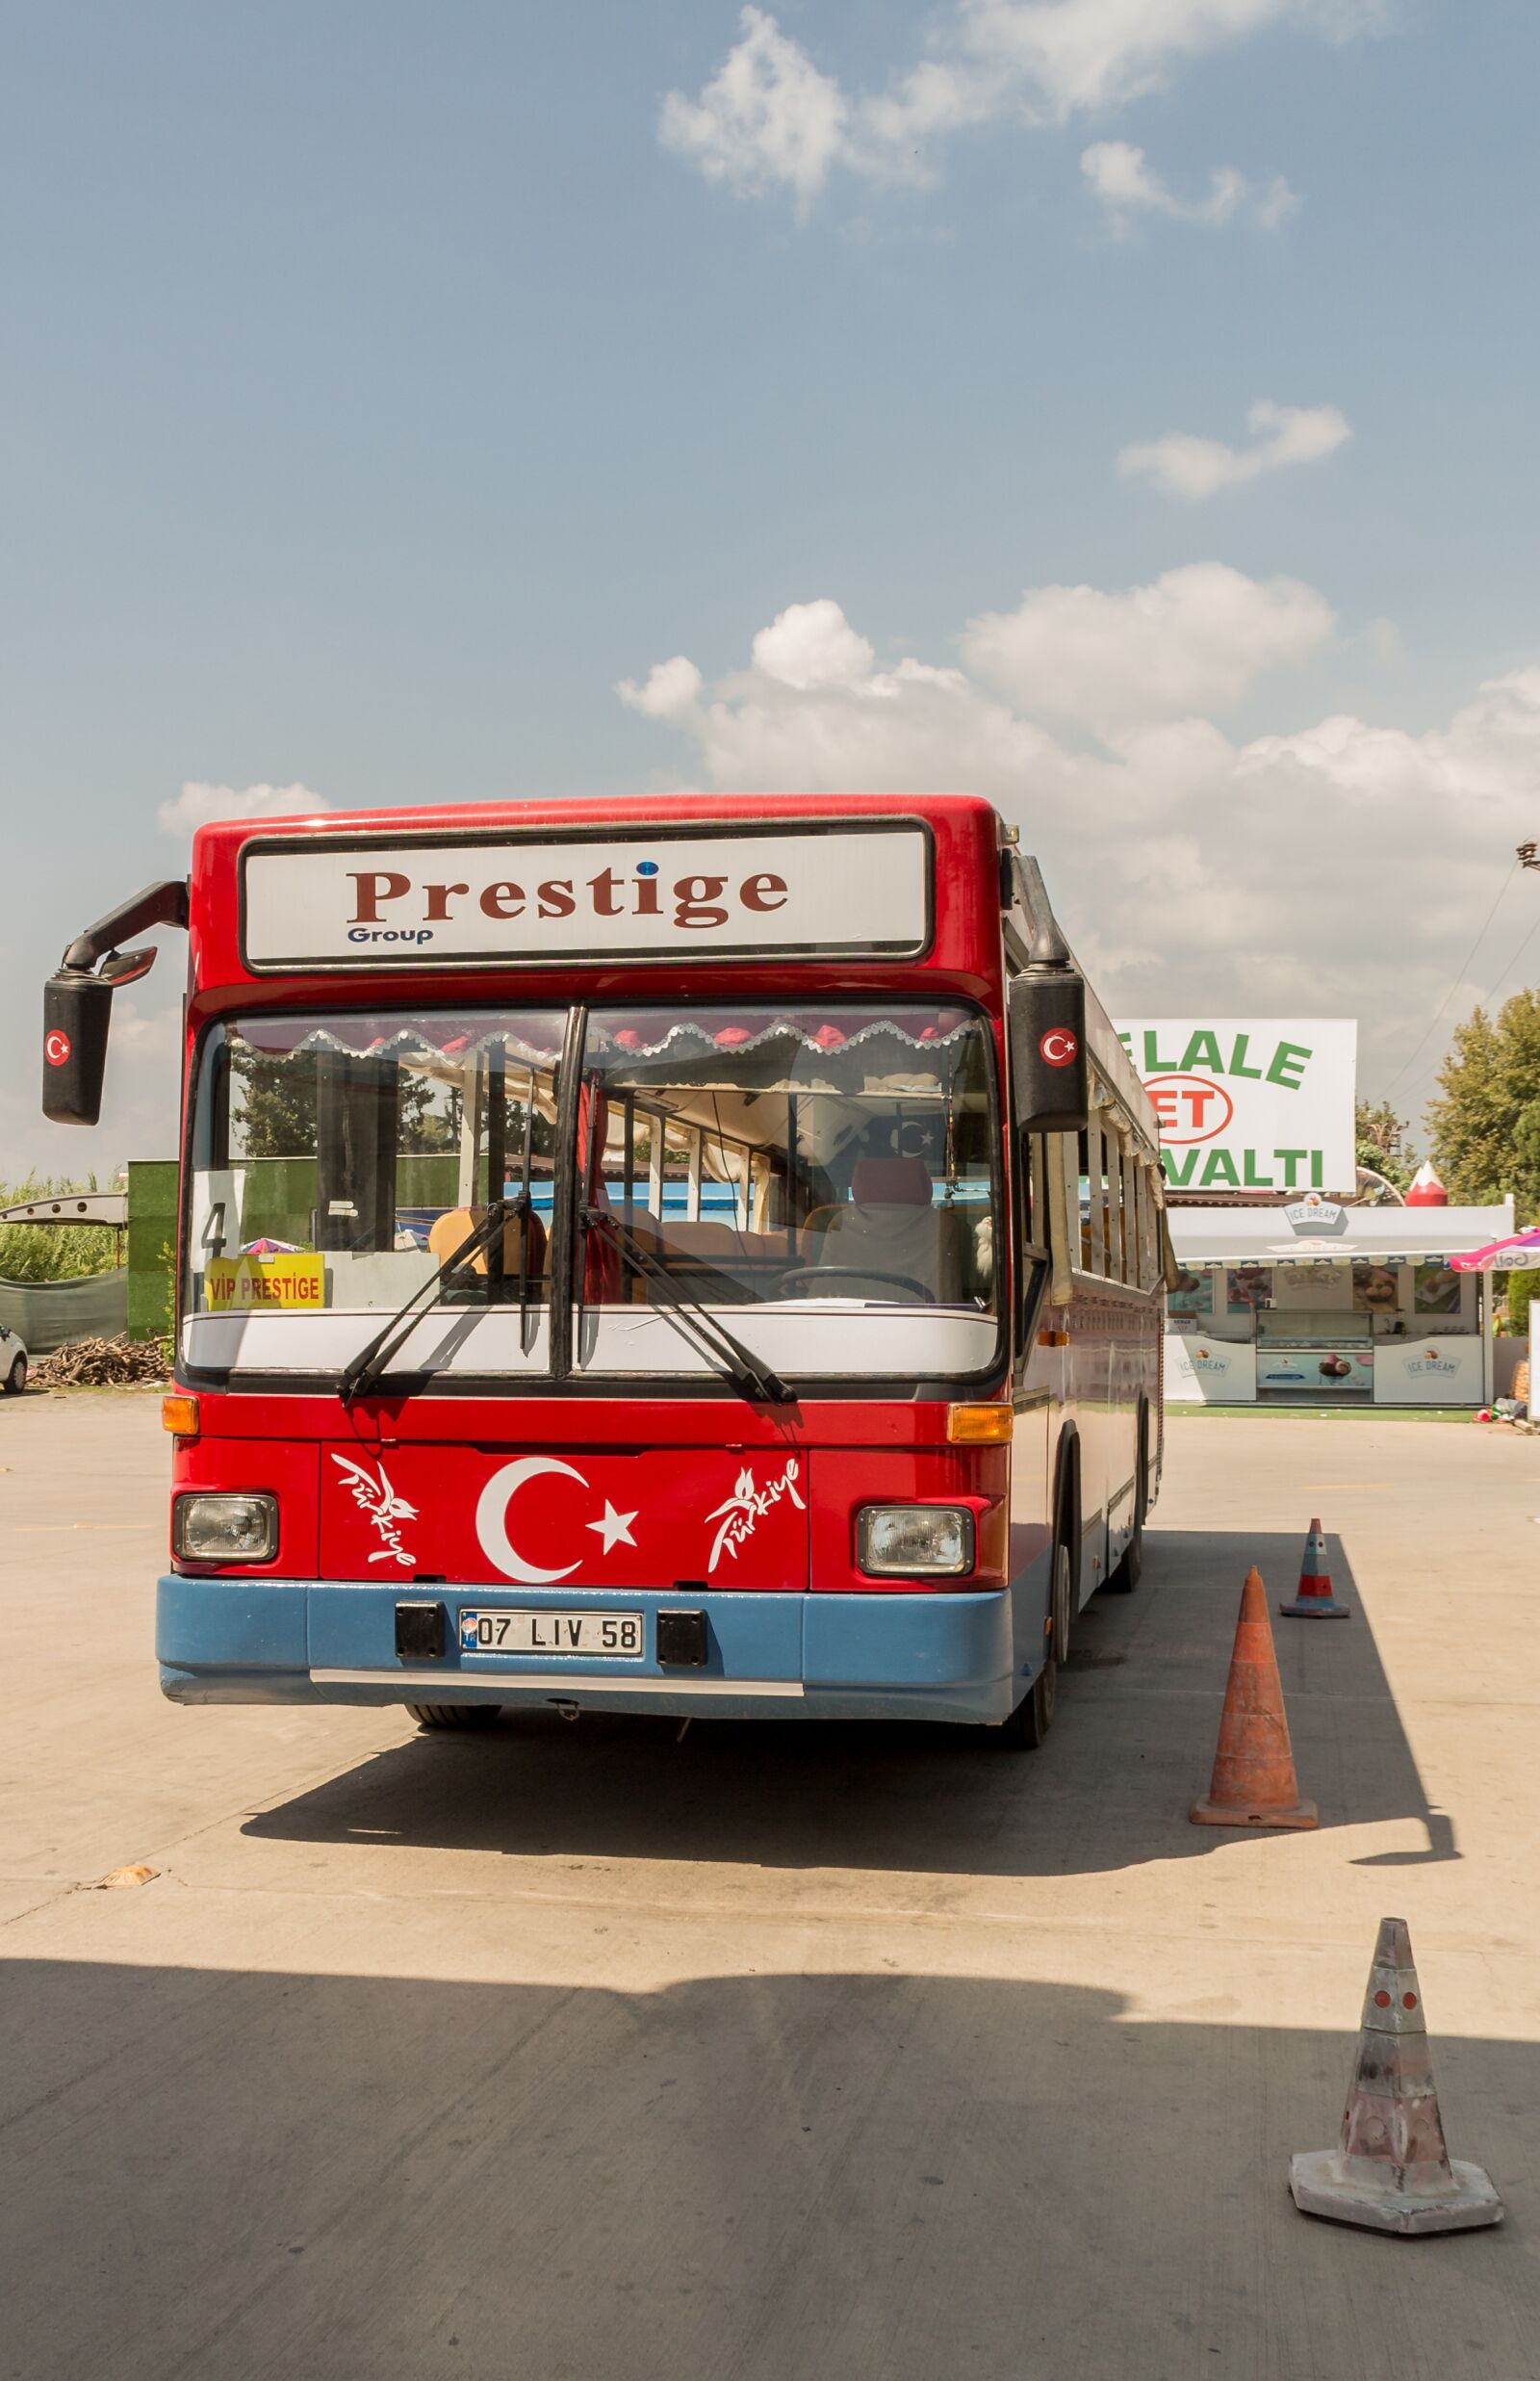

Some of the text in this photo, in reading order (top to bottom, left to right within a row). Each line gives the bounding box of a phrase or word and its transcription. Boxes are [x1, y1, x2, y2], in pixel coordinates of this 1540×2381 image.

[346, 862, 789, 929] Prestige
[346, 927, 434, 945] Group
[1146, 1090, 1215, 1128] ET
[1289, 1207, 1337, 1221] ICE DREAM
[201, 1203, 227, 1257] 4
[242, 1272, 320, 1301] PRESTİGE
[1180, 1359, 1225, 1372] ICE DREAM
[1408, 1359, 1455, 1373] ICE DREAM
[331, 1453, 417, 1566] Türkiye
[706, 1458, 807, 1573] Türkiye
[477, 1618, 636, 1648] 07 LIV 58
